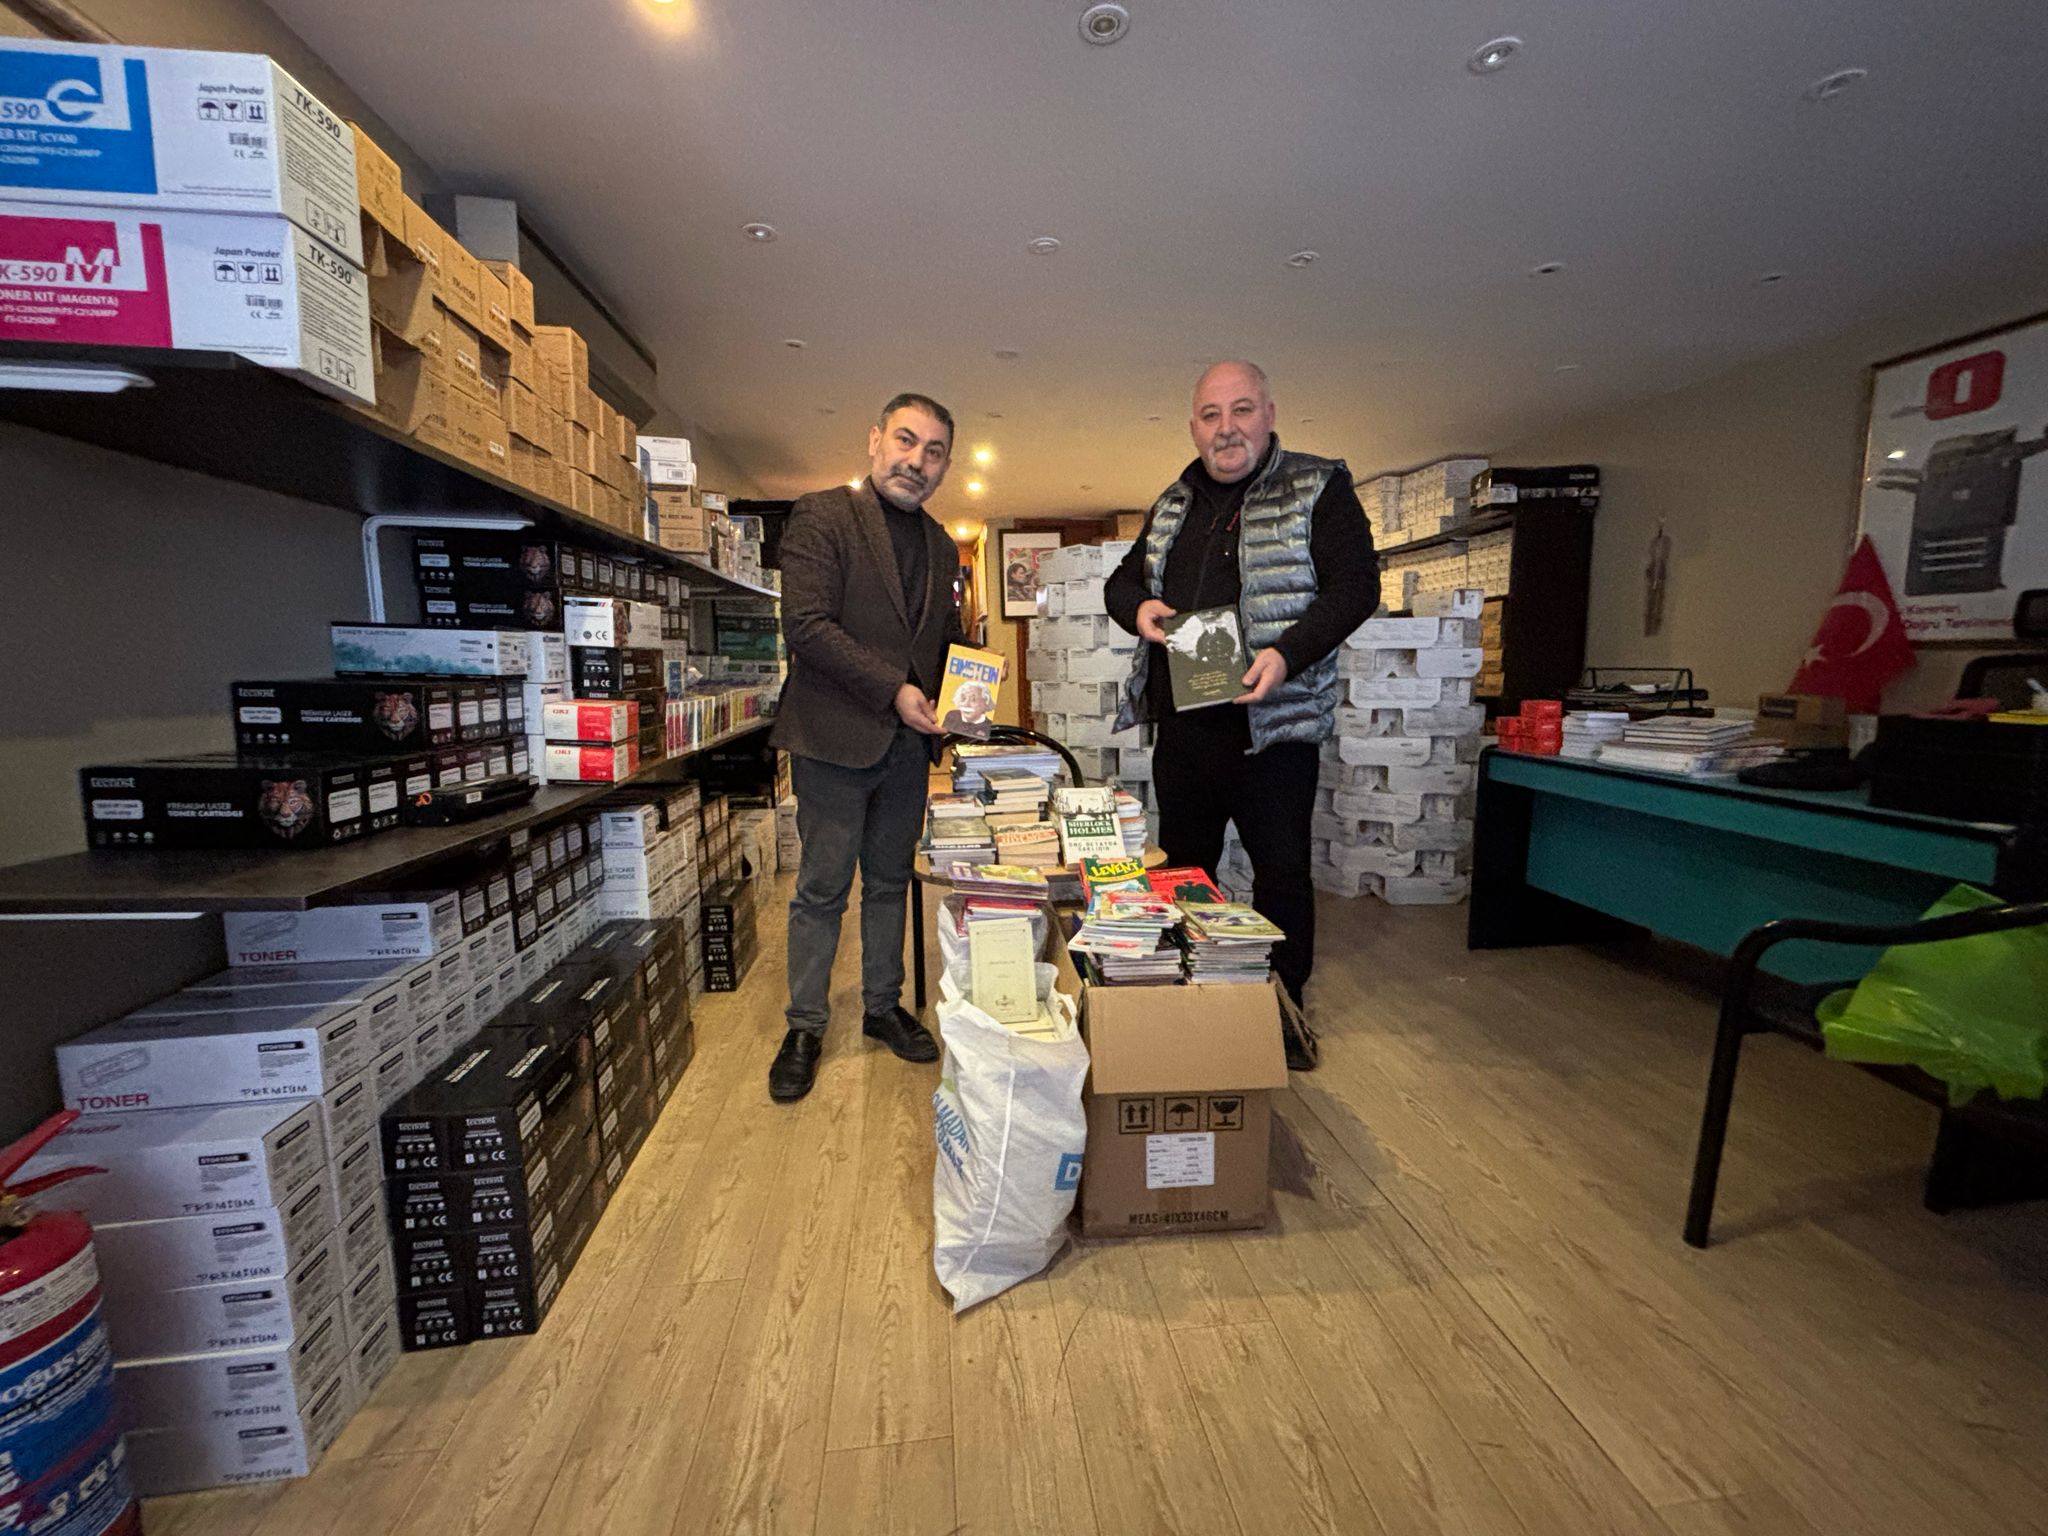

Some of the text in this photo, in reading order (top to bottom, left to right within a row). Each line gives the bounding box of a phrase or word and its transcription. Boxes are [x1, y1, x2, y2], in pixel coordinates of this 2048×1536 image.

[199, 83, 265, 95] Japan Powder
[294, 88, 341, 138] TK-590
[214, 247, 281, 259] Japan Powder
[309, 244, 352, 285] TK-590
[33, 291, 55, 302] KIT
[57, 294, 119, 307] (MAGENTA)
[949, 656, 999, 685] EINSTEIN
[208, 802, 233, 810] LASER
[167, 810, 245, 818] TONER CARTRIDGE
[1068, 820, 1112, 828] SHERLOCK
[1069, 826, 1114, 835] HOLMES
[1090, 862, 1139, 877] LEVENT
[239, 951, 295, 963] TONER
[78, 1092, 149, 1110] TONER
